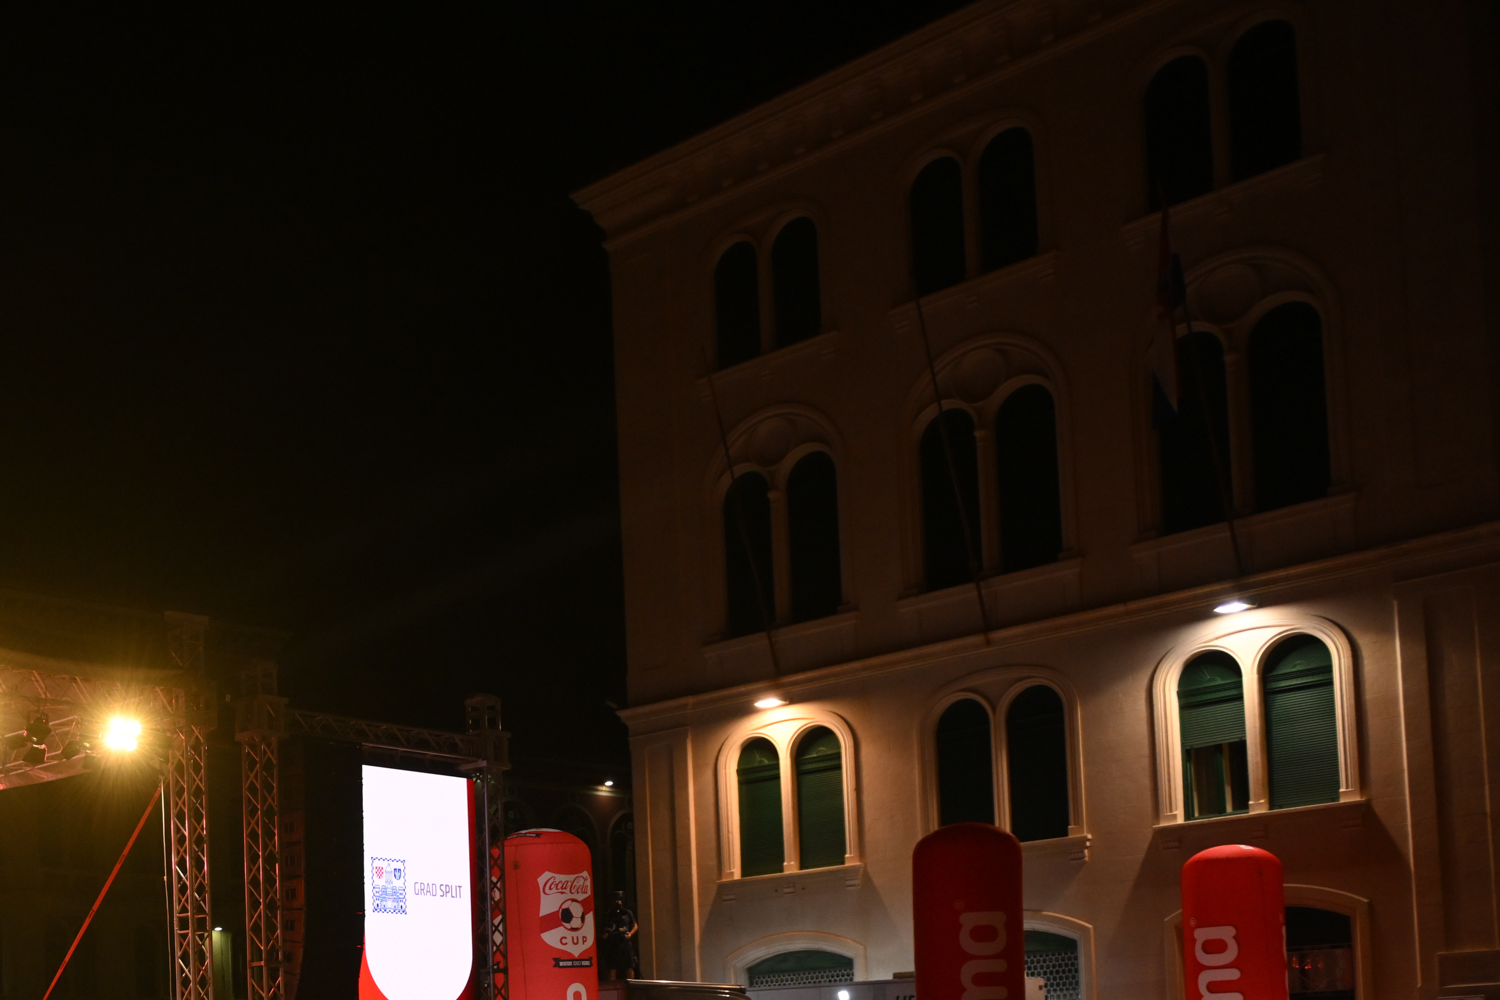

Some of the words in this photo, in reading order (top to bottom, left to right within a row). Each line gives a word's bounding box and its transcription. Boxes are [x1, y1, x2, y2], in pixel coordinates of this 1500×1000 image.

[413, 881, 438, 897] GRAD
[439, 883, 463, 899] SPLIT
[542, 874, 589, 896] Coca-Cola
[559, 935, 588, 946] CUP
